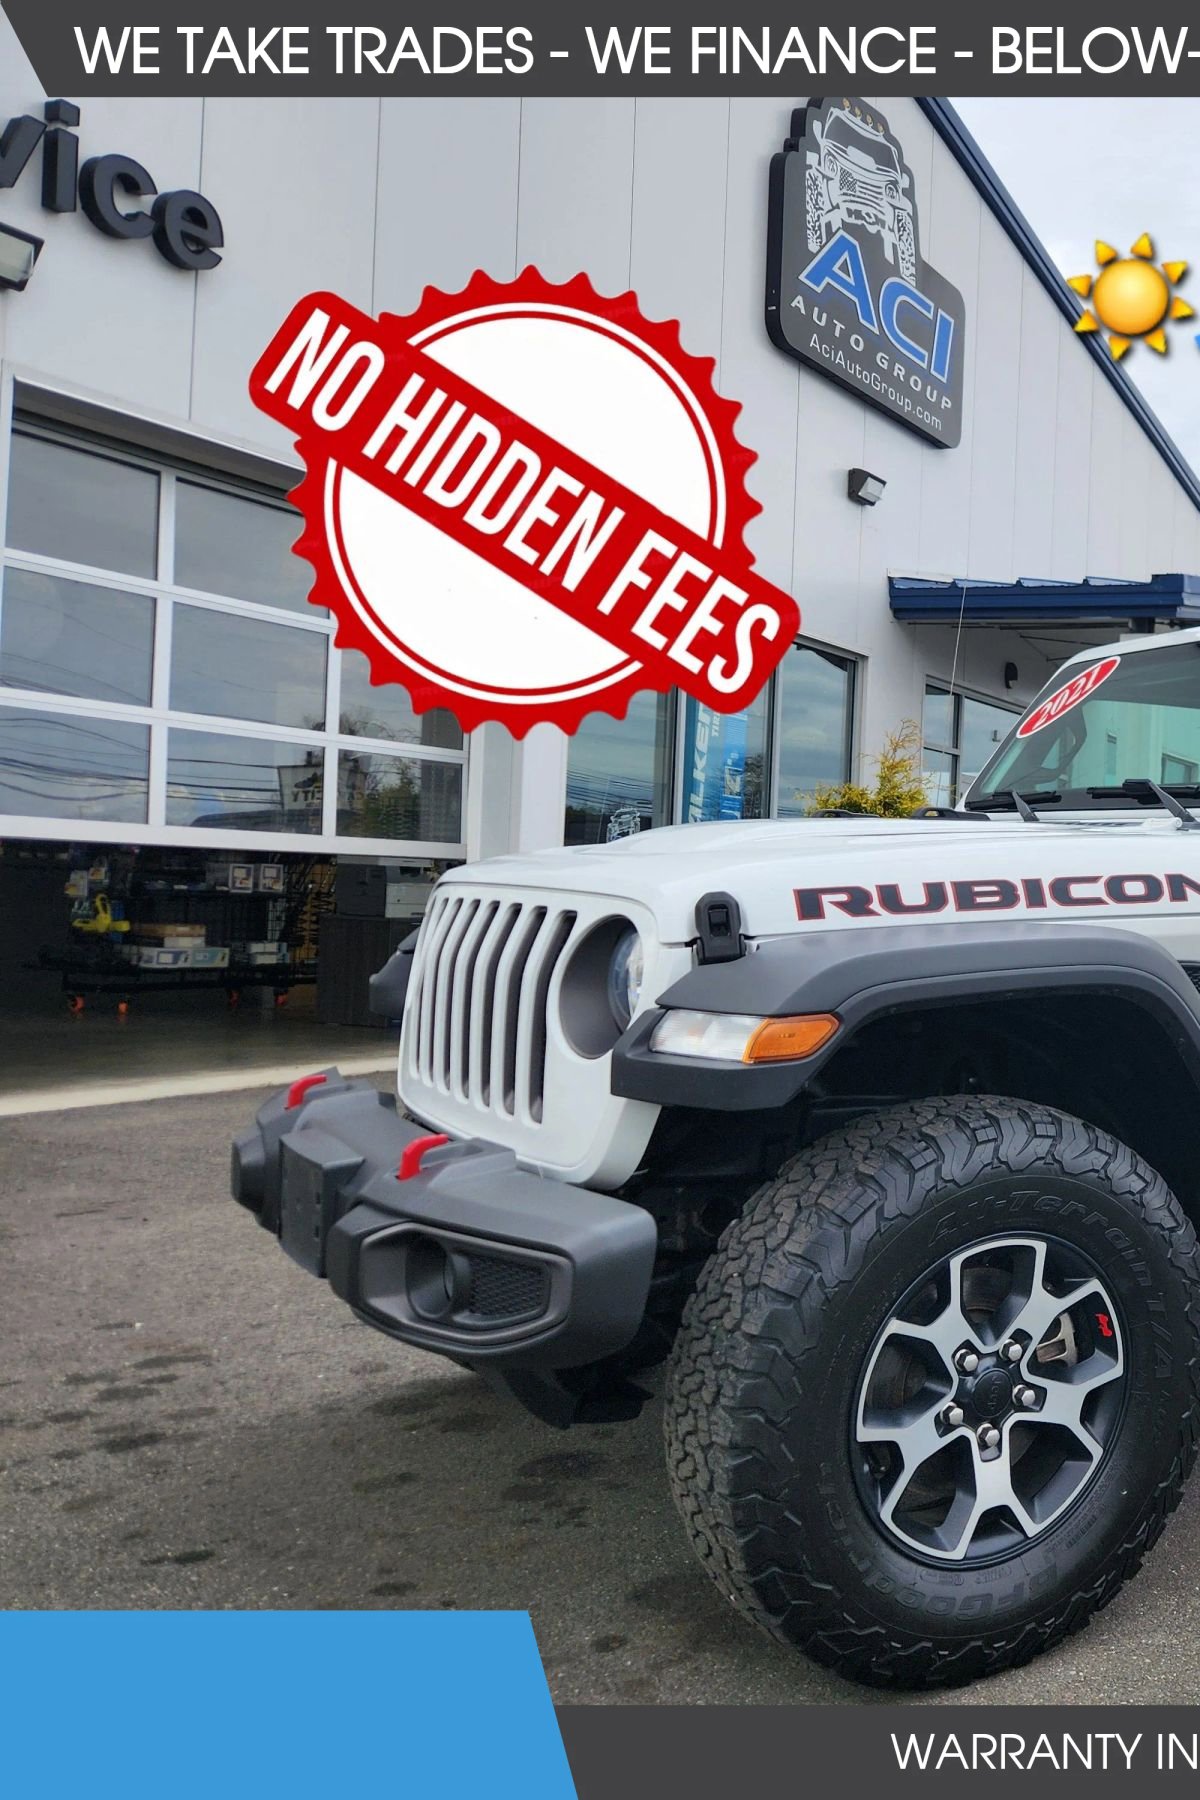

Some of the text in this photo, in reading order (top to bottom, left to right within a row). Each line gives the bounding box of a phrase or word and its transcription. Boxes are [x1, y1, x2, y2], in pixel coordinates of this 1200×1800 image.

[790, 294, 952, 411] AUTO GROUP
[798, 228, 955, 384] ACI
[809, 334, 942, 431] AciAutoGroup.com
[1032, 664, 1101, 730] 2021
